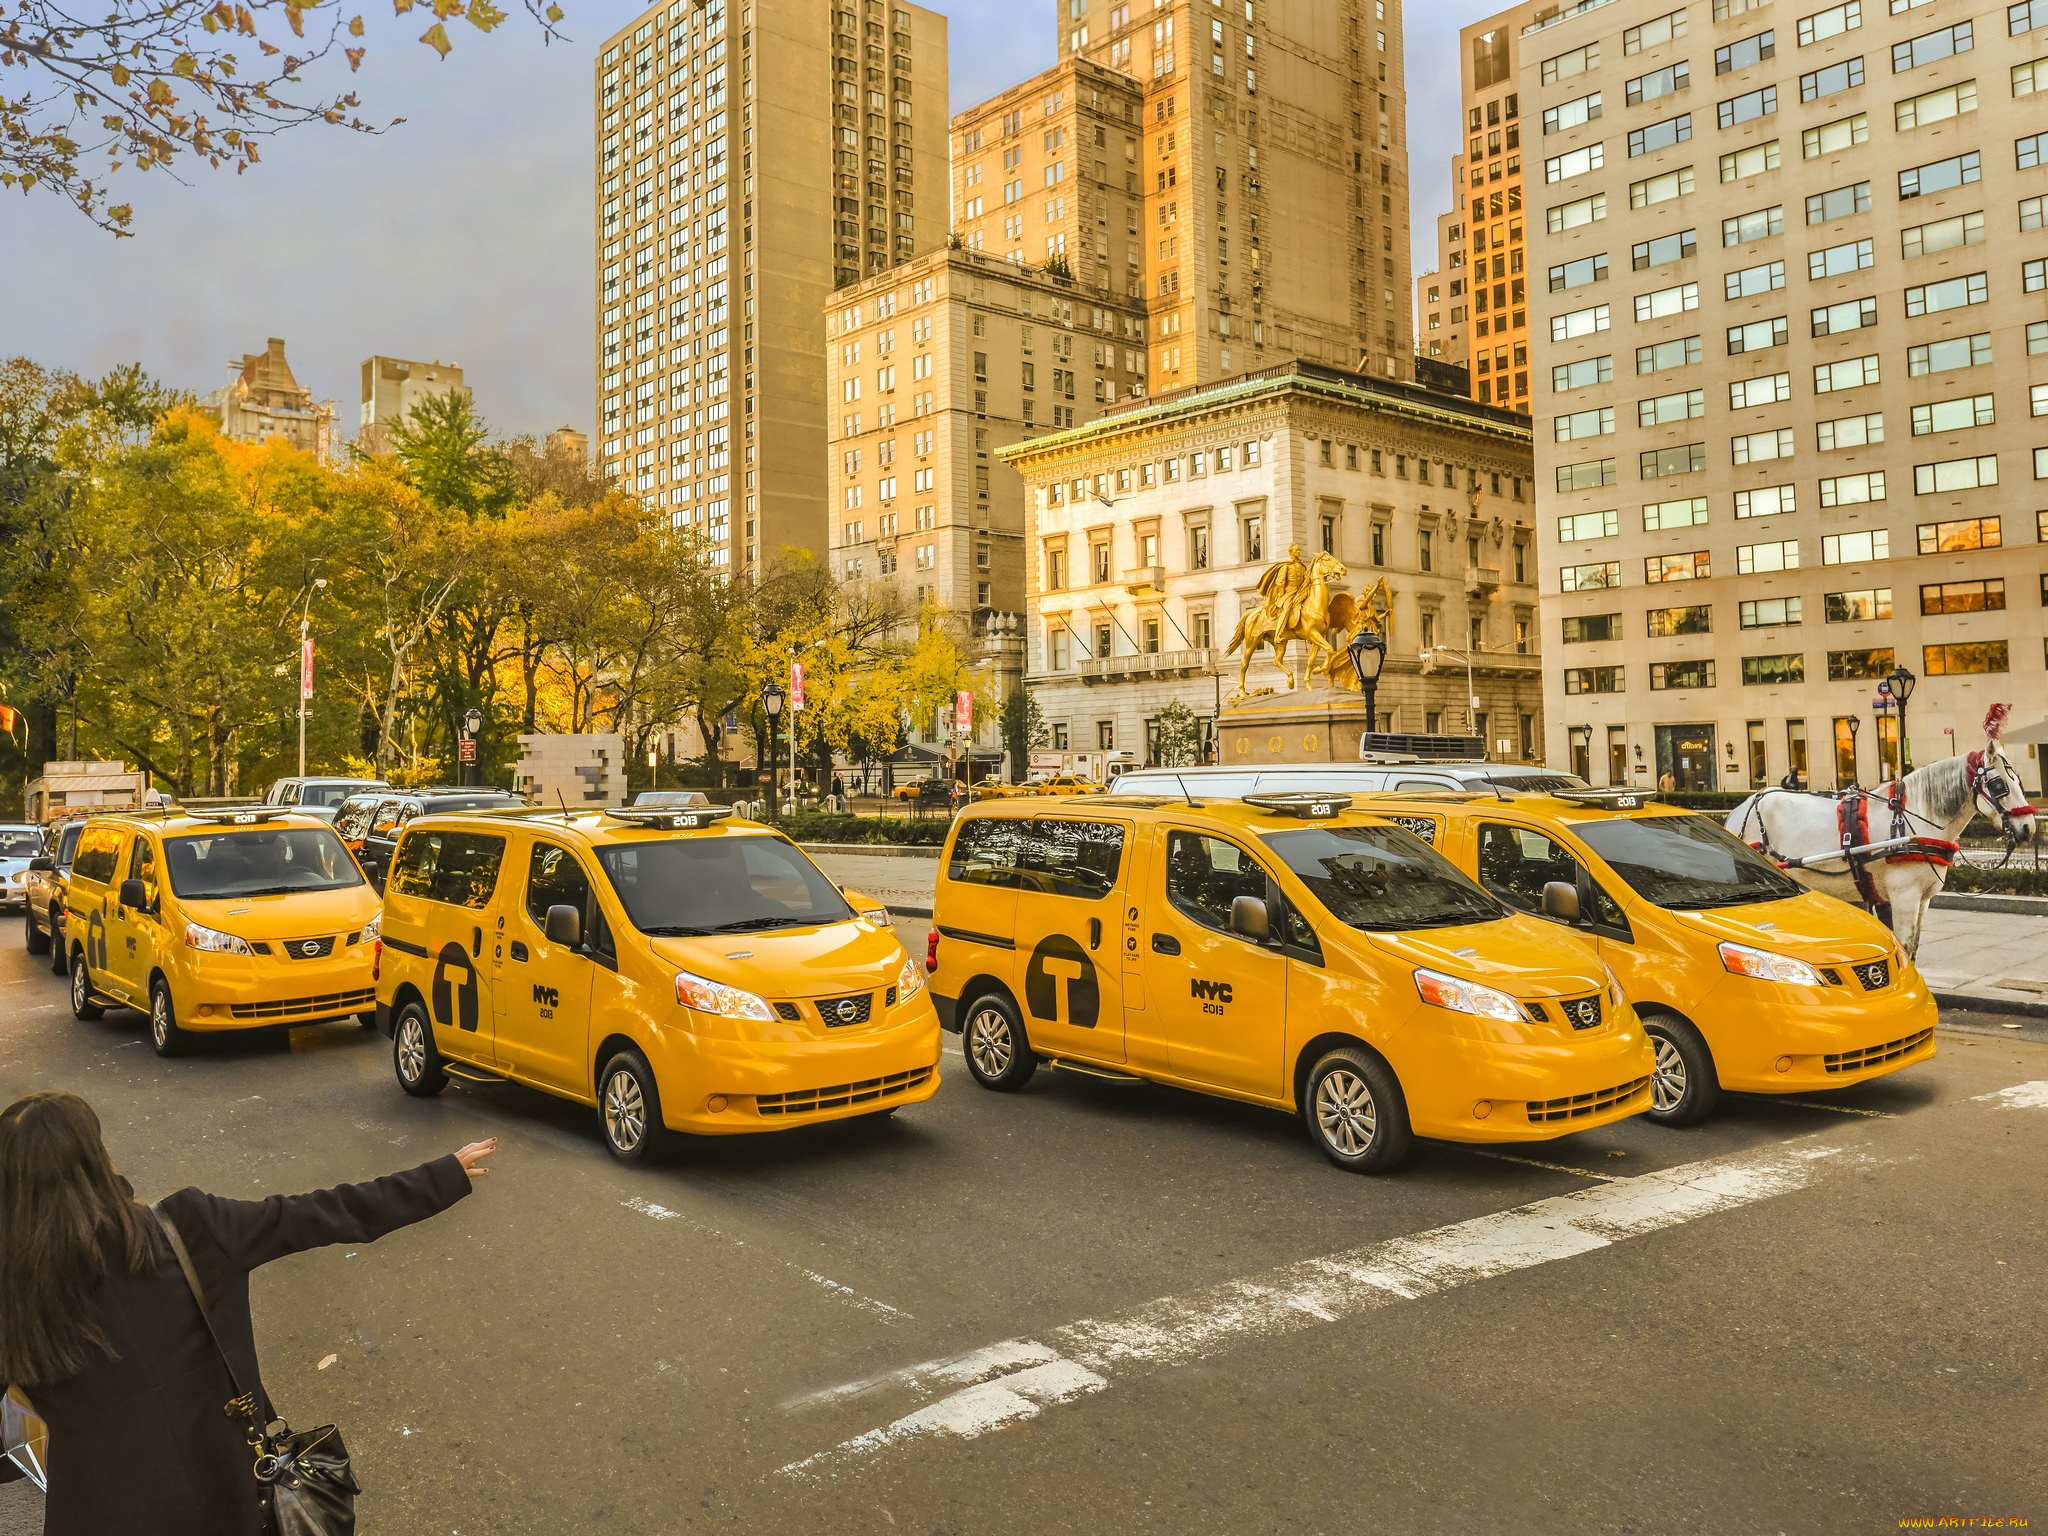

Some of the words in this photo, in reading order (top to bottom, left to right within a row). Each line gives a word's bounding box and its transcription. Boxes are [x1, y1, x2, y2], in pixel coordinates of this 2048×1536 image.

[1617, 796, 1637, 807] 2013
[1311, 804, 1331, 815] 2013
[234, 814, 257, 824] 2013
[673, 815, 698, 826] 2013
[533, 984, 559, 1008] NYC
[1191, 978, 1233, 1004] NYC
[540, 1008, 554, 1020] 2013
[1203, 1003, 1224, 1016] 2013
